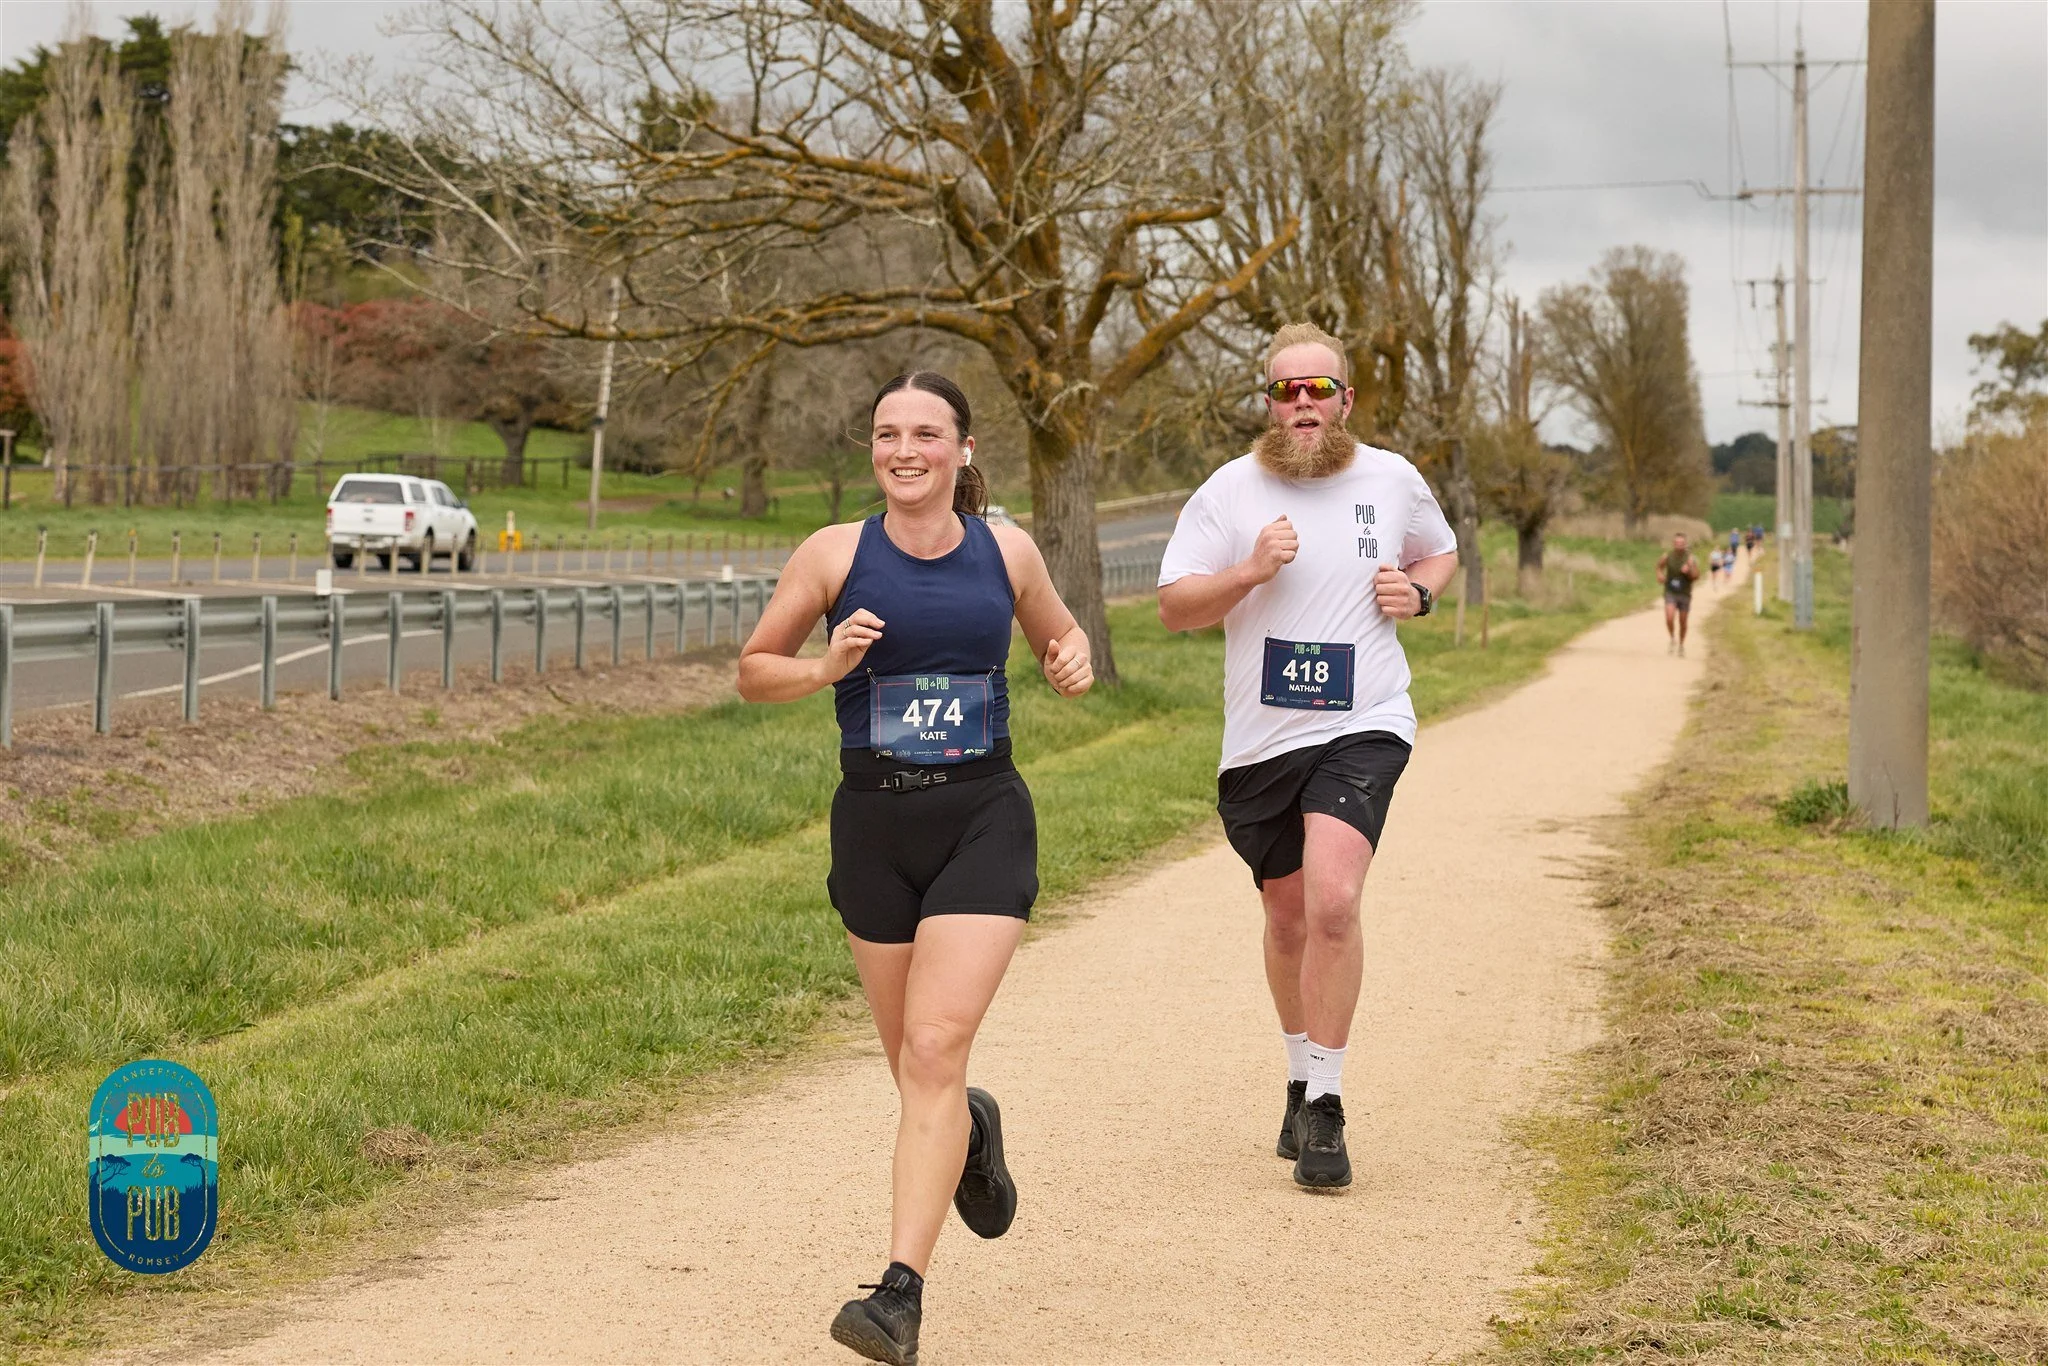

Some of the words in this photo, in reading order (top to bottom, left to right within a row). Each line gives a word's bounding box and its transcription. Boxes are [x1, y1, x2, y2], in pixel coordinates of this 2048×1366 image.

[1355, 504, 1375, 525] PUB
[1358, 537, 1378, 559] PUB
[1294, 643, 1305, 654] PUB
[1310, 644, 1321, 655] PUB
[1282, 659, 1329, 684] 418
[915, 677, 929, 691] PUB
[936, 676, 950, 690] PUB
[1288, 683, 1322, 693] NATHAN
[902, 698, 964, 728] 474
[920, 731, 948, 741] KATE
